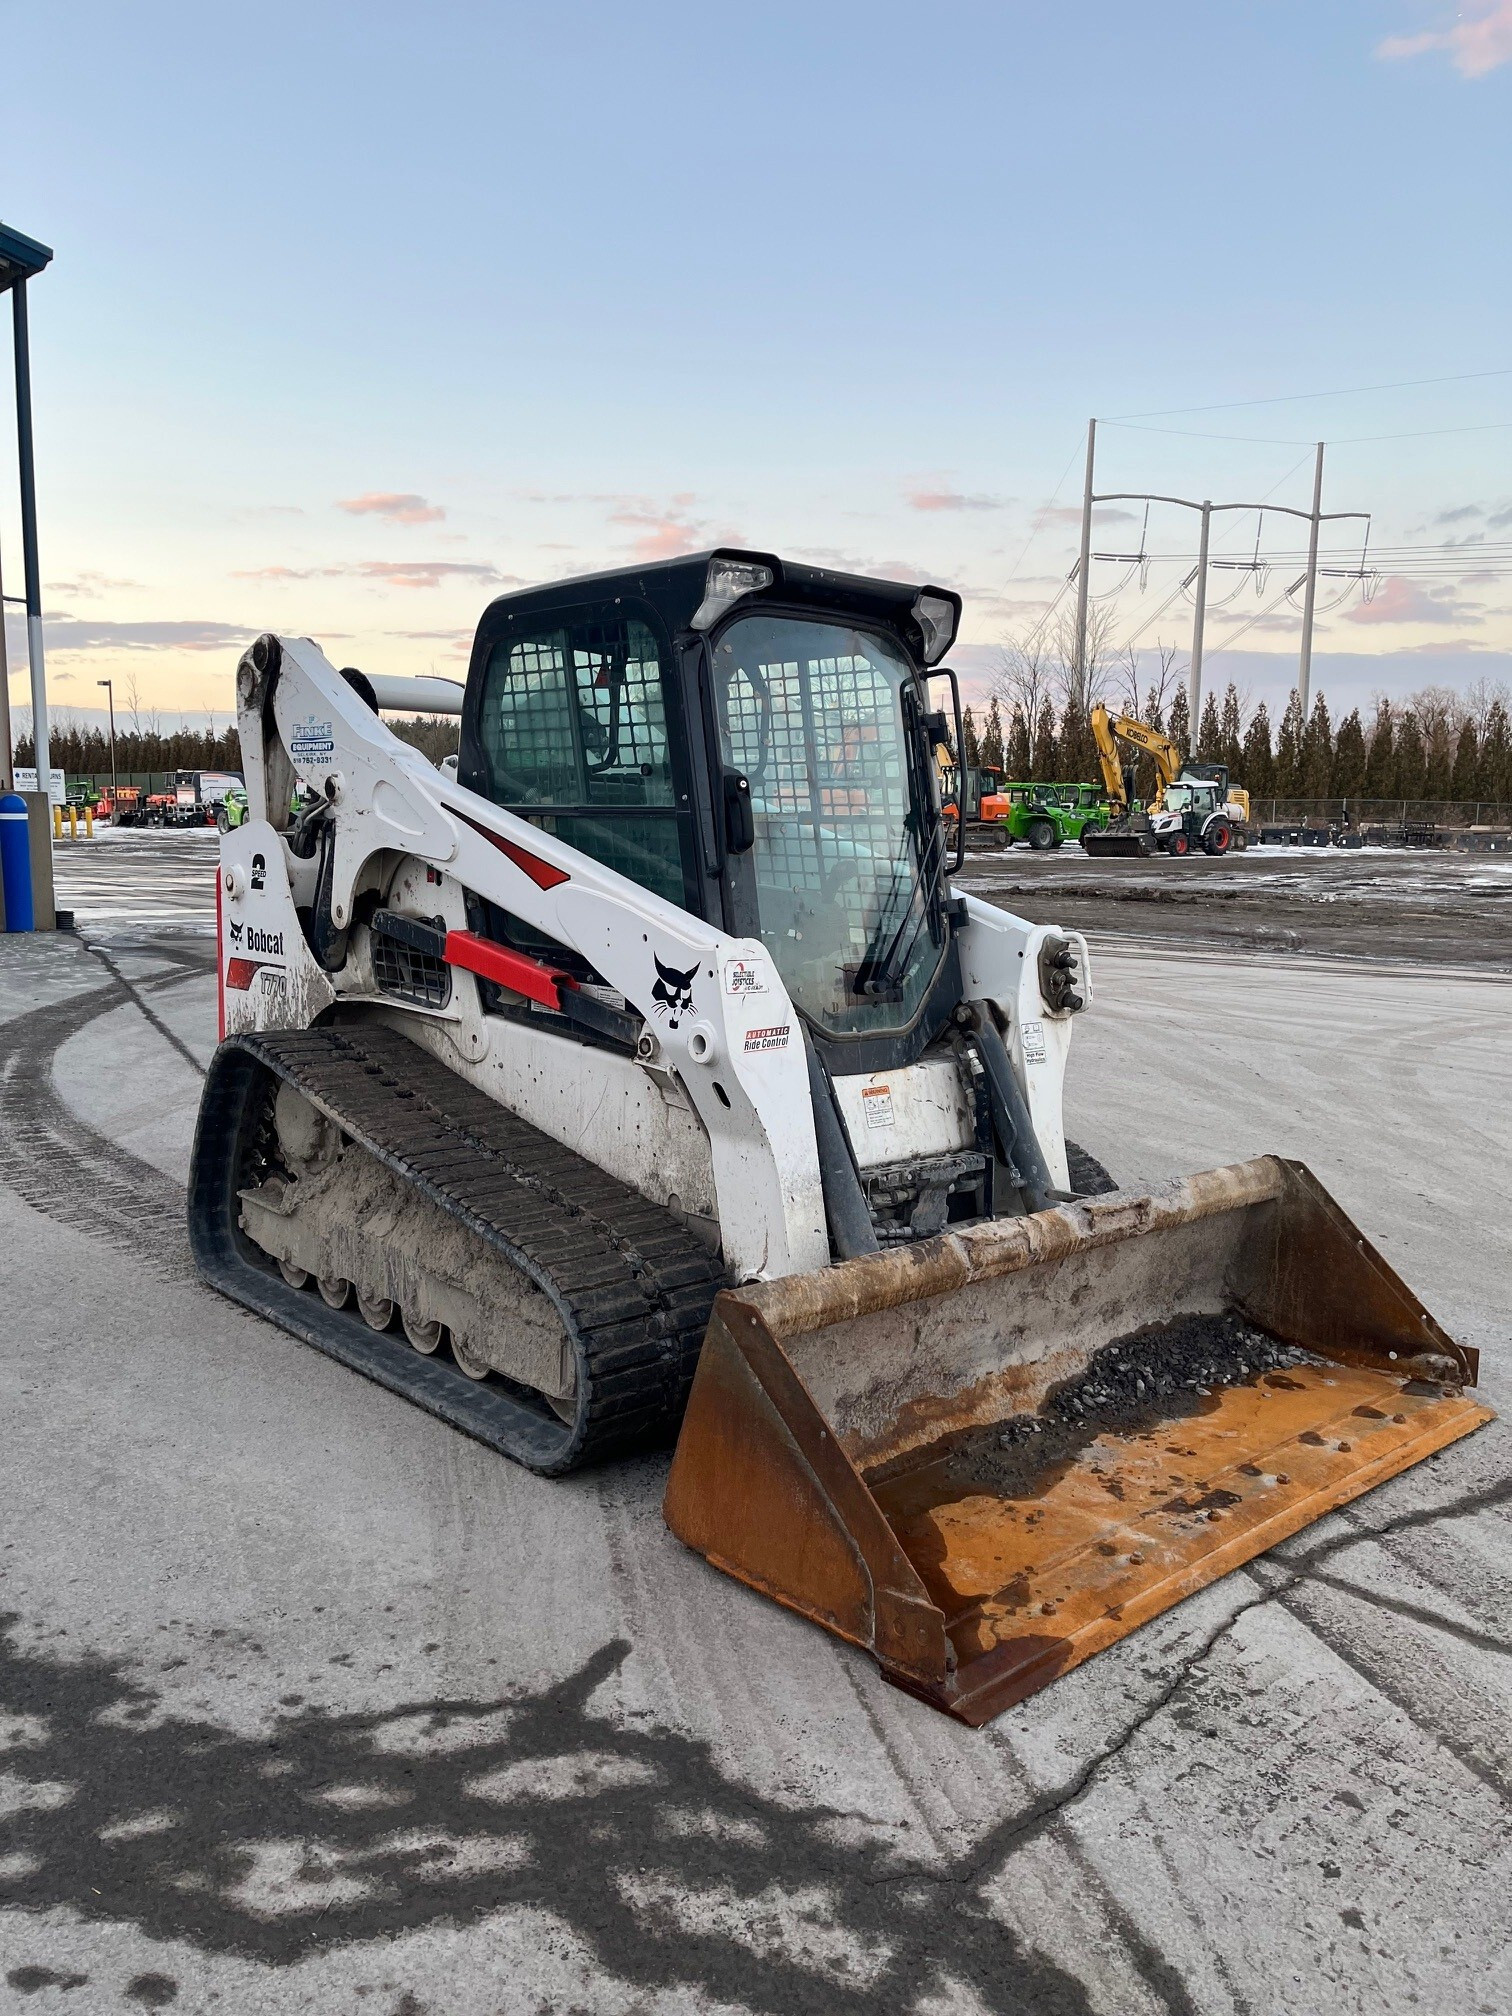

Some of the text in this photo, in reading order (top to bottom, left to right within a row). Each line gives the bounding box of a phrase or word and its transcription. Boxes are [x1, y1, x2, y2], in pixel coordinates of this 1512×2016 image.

[292, 722, 332, 737] FINKE
[1126, 727, 1149, 744] KOBELCO
[292, 742, 332, 751] EQUIPMENT
[251, 853, 265, 890] 2
[247, 926, 283, 955] Bobcat
[260, 972, 287, 998] T770
[746, 1027, 789, 1039] AUTOMATIC
[744, 1036, 788, 1051] Ride Control
